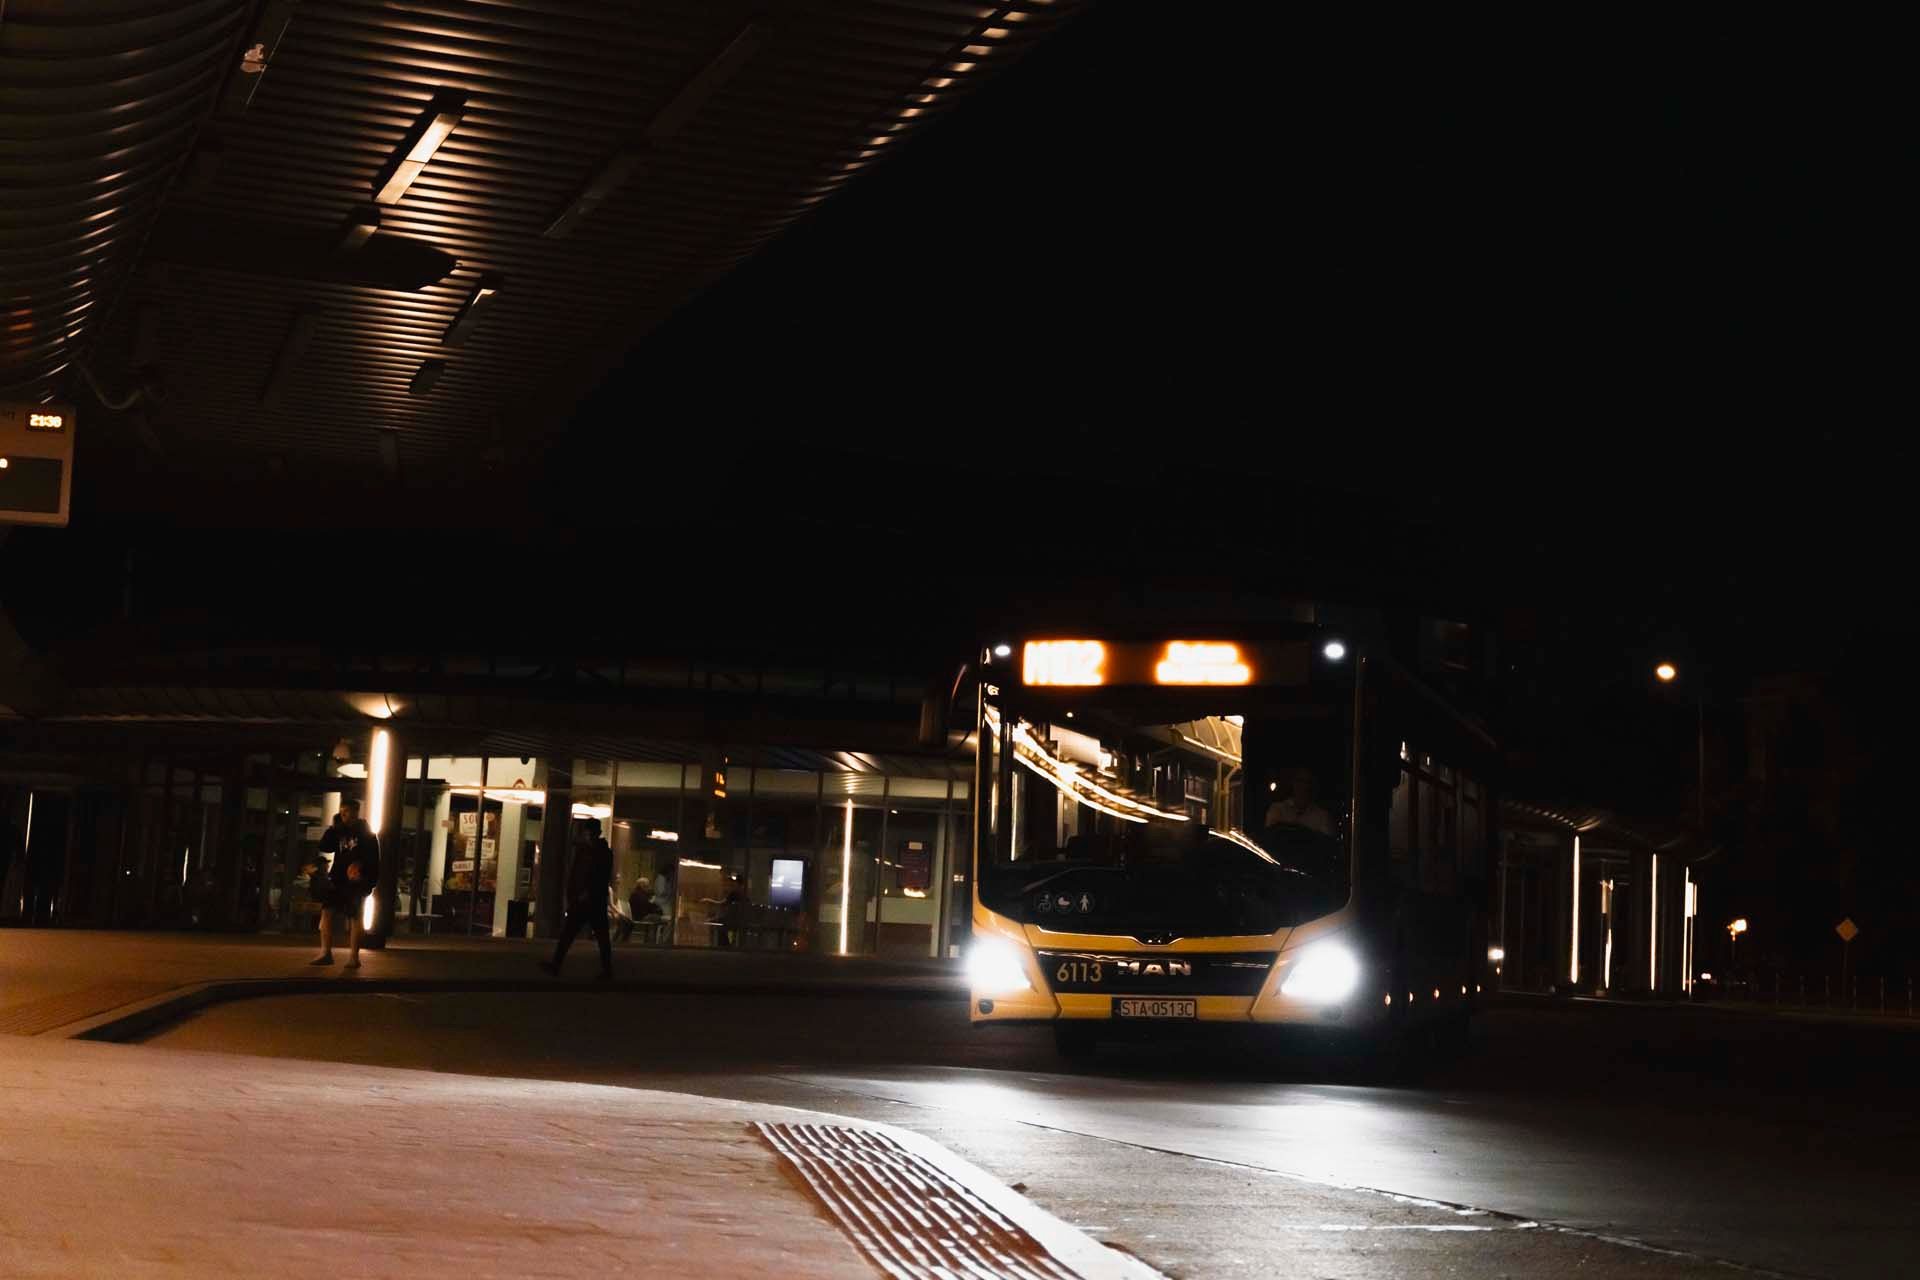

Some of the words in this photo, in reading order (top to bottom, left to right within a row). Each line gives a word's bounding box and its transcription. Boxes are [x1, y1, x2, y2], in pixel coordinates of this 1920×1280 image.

[1056, 962, 1102, 982] 6113
[1117, 960, 1192, 976] MAN
[1121, 1000, 1148, 1016] STA
[1151, 1001, 1194, 1017] 0513C
